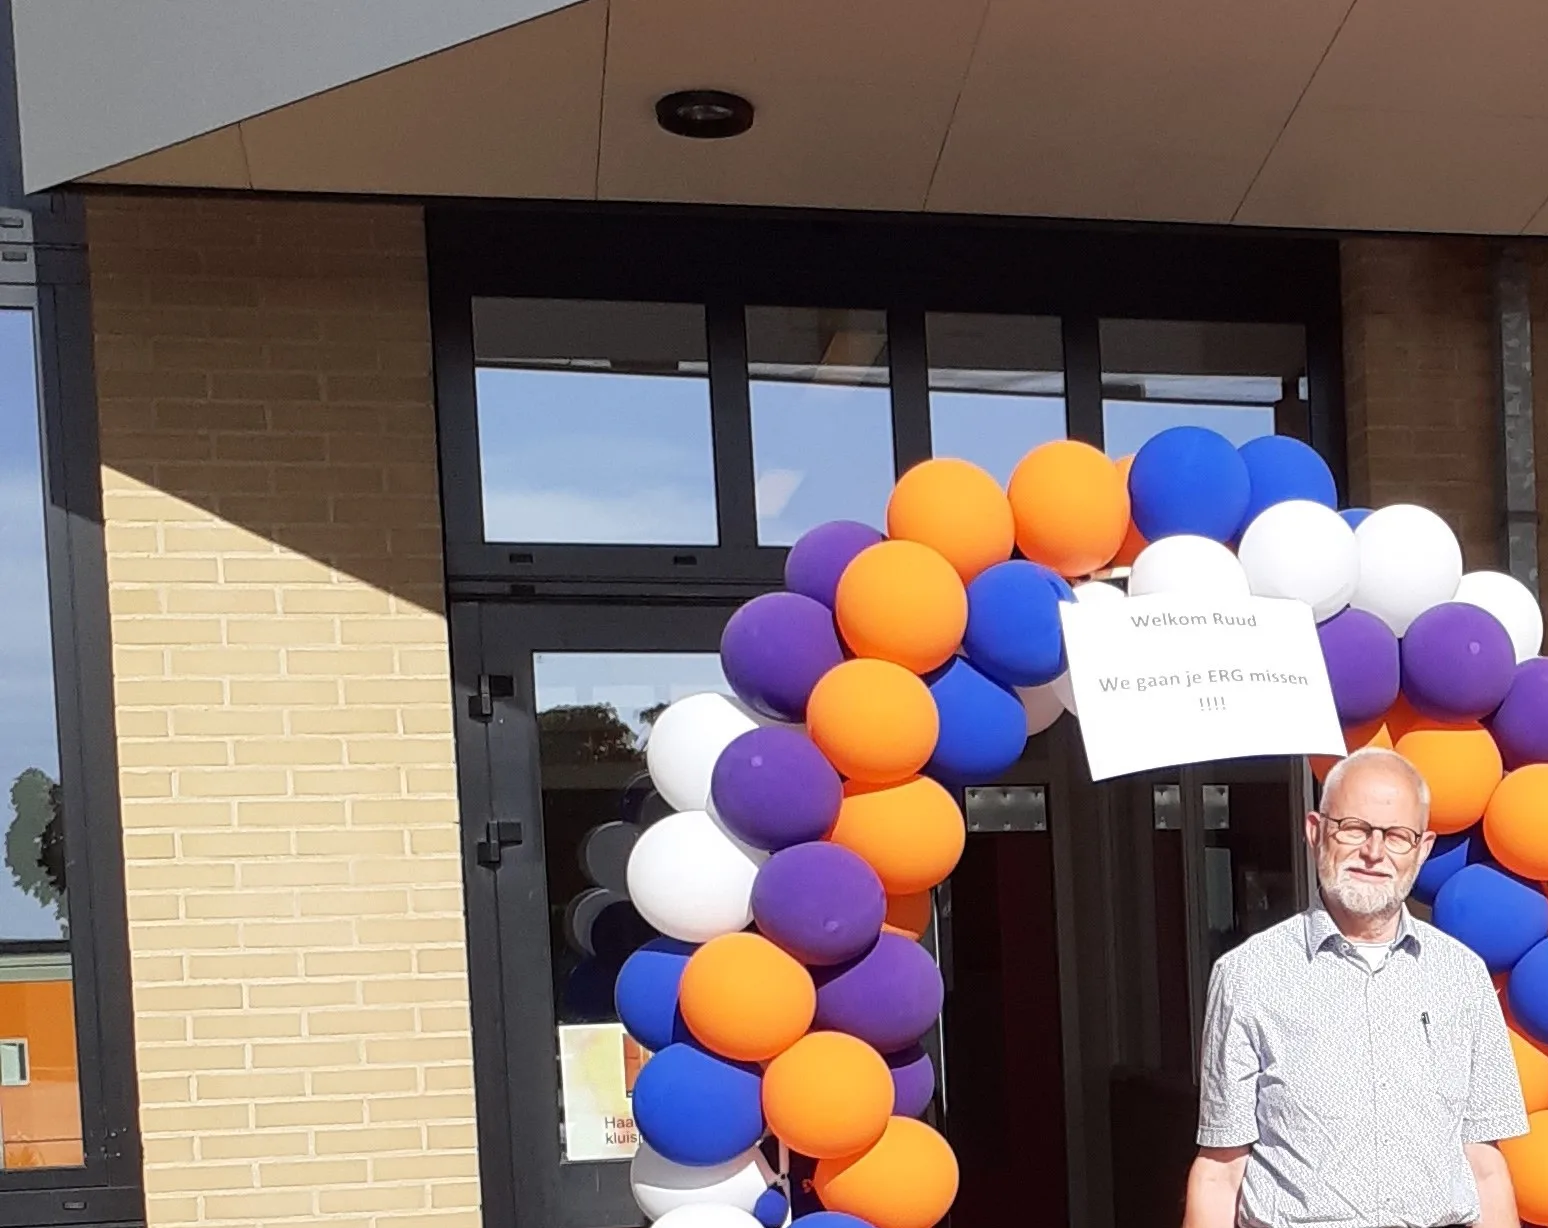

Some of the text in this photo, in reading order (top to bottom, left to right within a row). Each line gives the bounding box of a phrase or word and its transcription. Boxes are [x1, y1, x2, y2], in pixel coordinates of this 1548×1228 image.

[1130, 612, 1257, 628] Welkom Ruud
[1098, 669, 1309, 692] We gaan je ERG missen
[1198, 696, 1227, 711] !!!!
